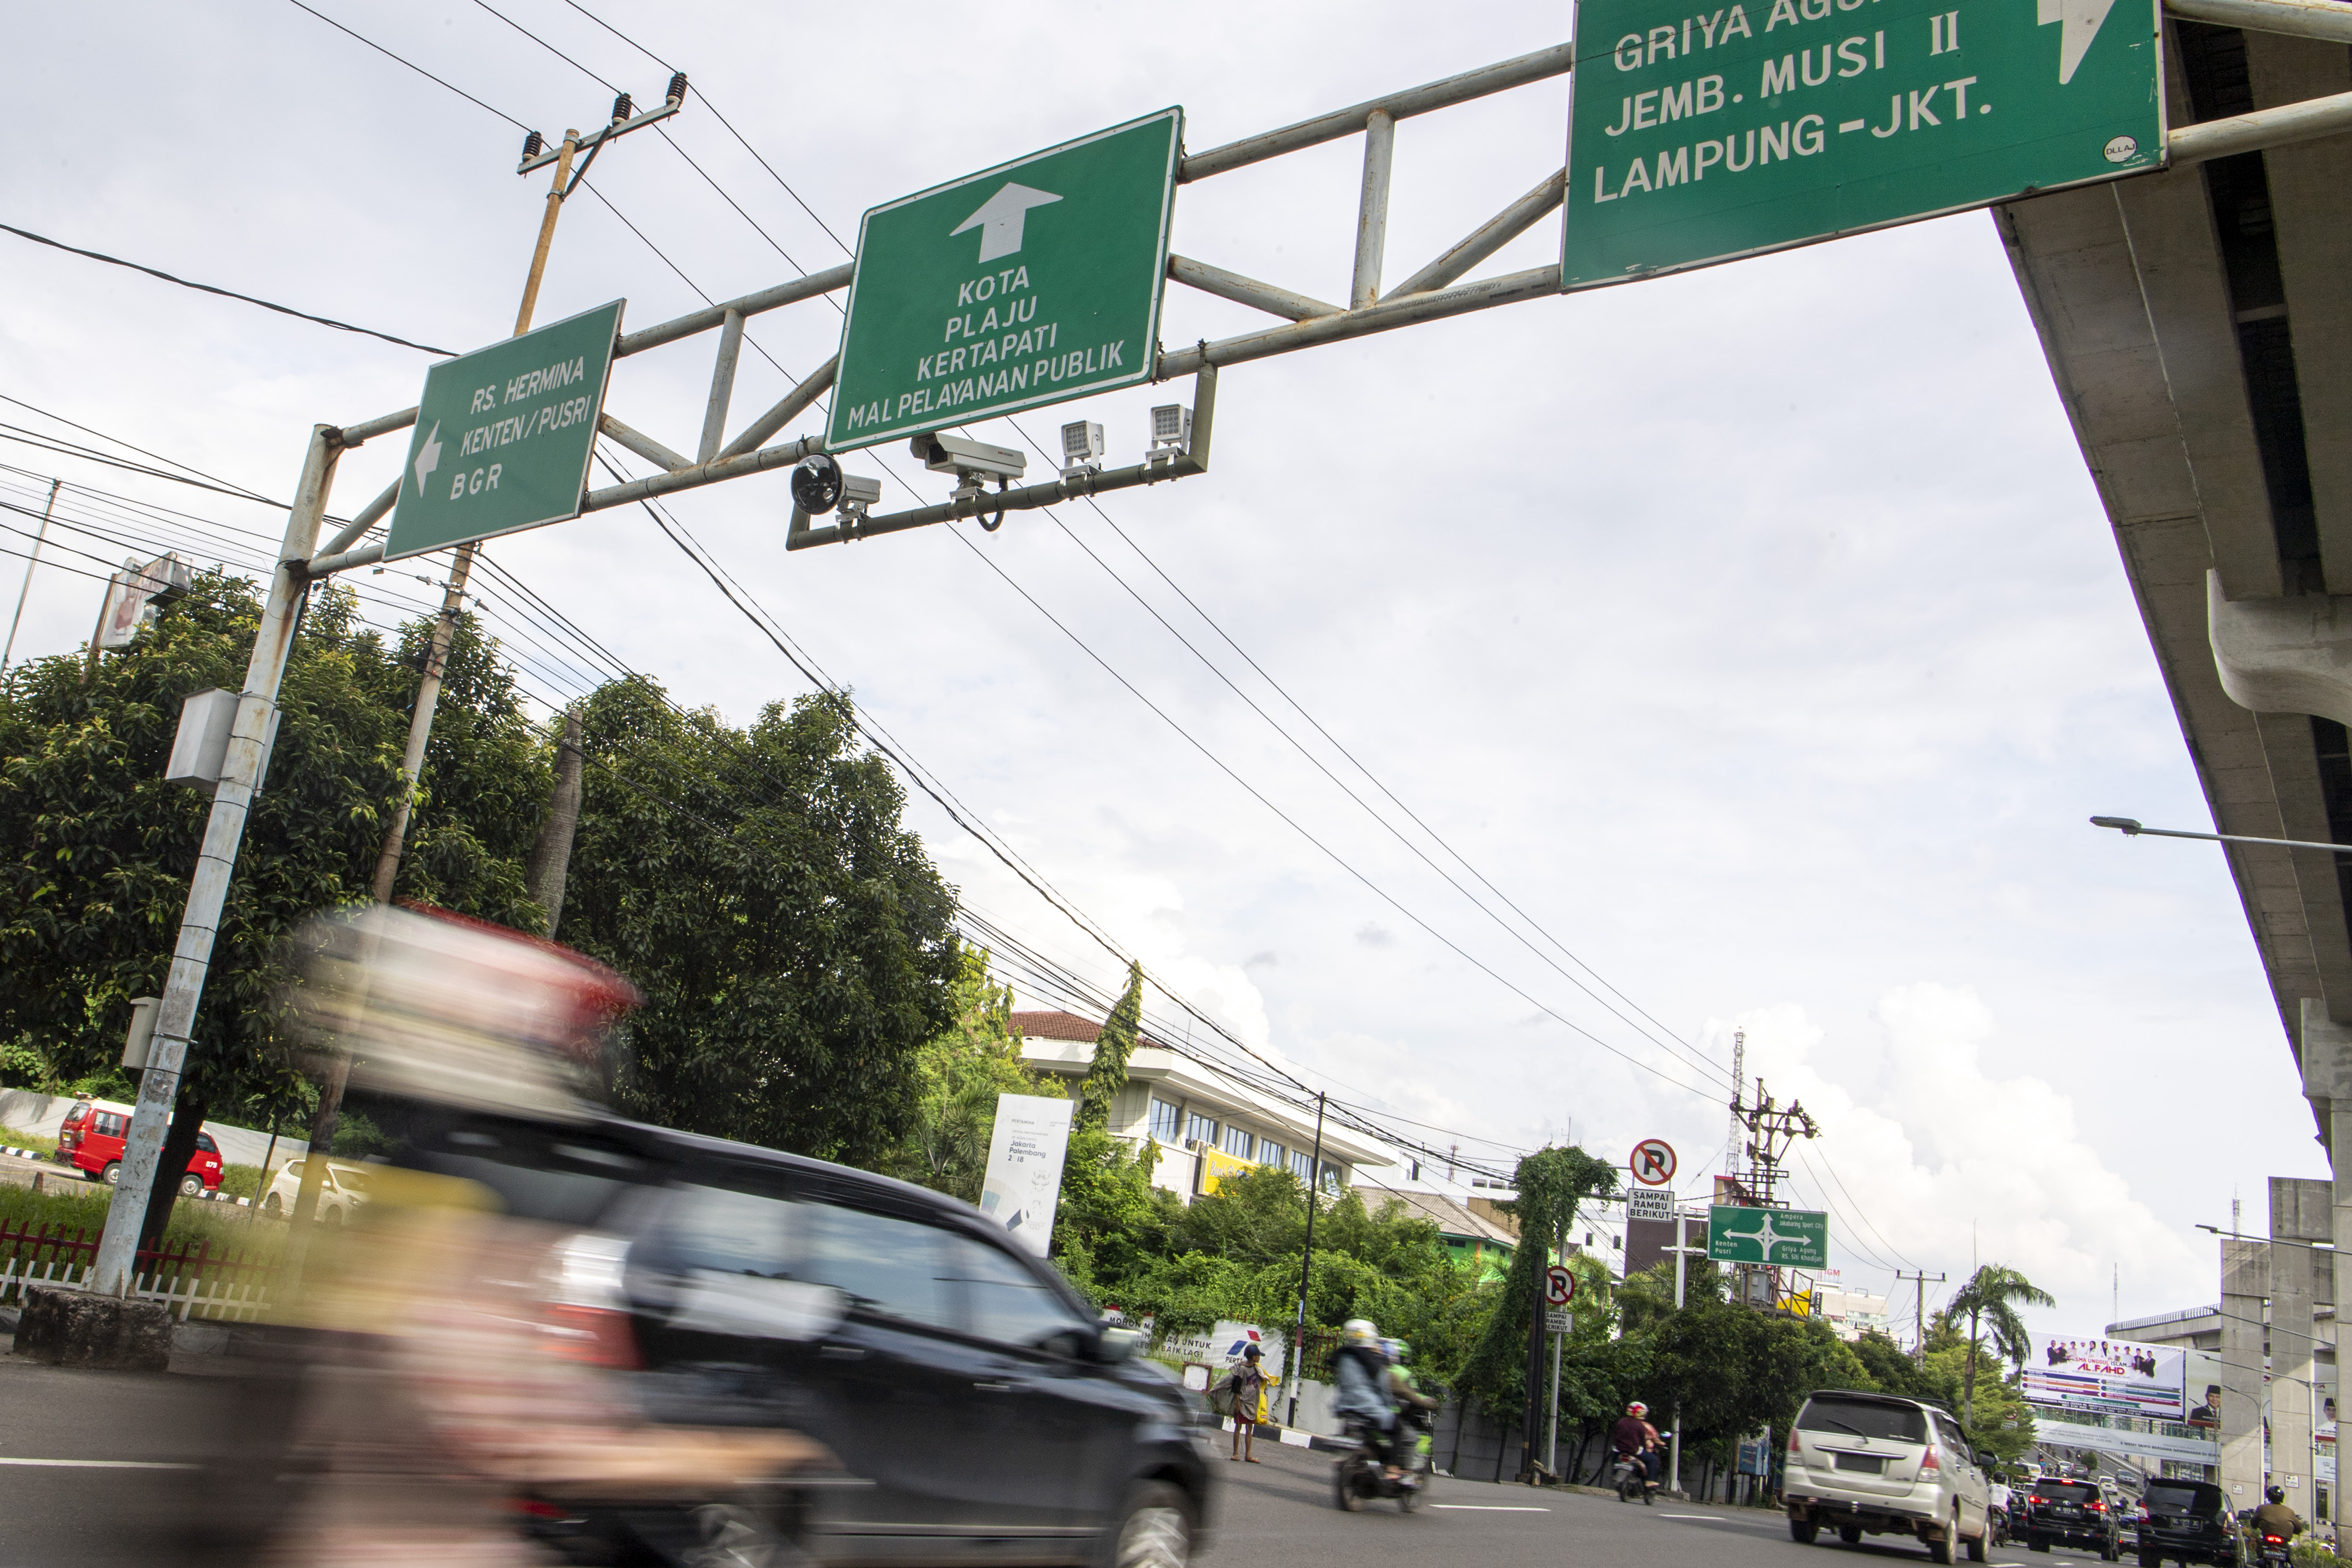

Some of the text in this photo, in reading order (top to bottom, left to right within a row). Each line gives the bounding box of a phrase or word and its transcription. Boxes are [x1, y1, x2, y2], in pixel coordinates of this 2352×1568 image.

[1615, 5, 1752, 72] GRIYA
[1605, 11, 1960, 136] JEMB. MUSI II
[958, 265, 1029, 307] KOTA
[945, 296, 1037, 343] PLAJU
[917, 322, 1057, 382] KERTAPATI
[470, 356, 584, 415] RS. HERMINA
[847, 340, 1124, 430] MAL PELAYANAN PUBLIK
[449, 463, 503, 500] BGR
[1010, 1140, 1035, 1149] Jakarta
[1009, 1146, 1046, 1159] Palembang
[1633, 1191, 1669, 1202] SAMPAI
[1633, 1200, 1667, 1210] RAMBU
[1630, 1208, 1671, 1219] BERIKUT
[1779, 1221, 1801, 1229] Jakabaring
[1799, 1247, 1817, 1255] Agung
[1800, 1255, 1823, 1263] Khodijah
[1109, 1316, 1141, 1328] MOHON
[1182, 1338, 1211, 1349] UNTUK
[1184, 1349, 1204, 1358] LAGI
